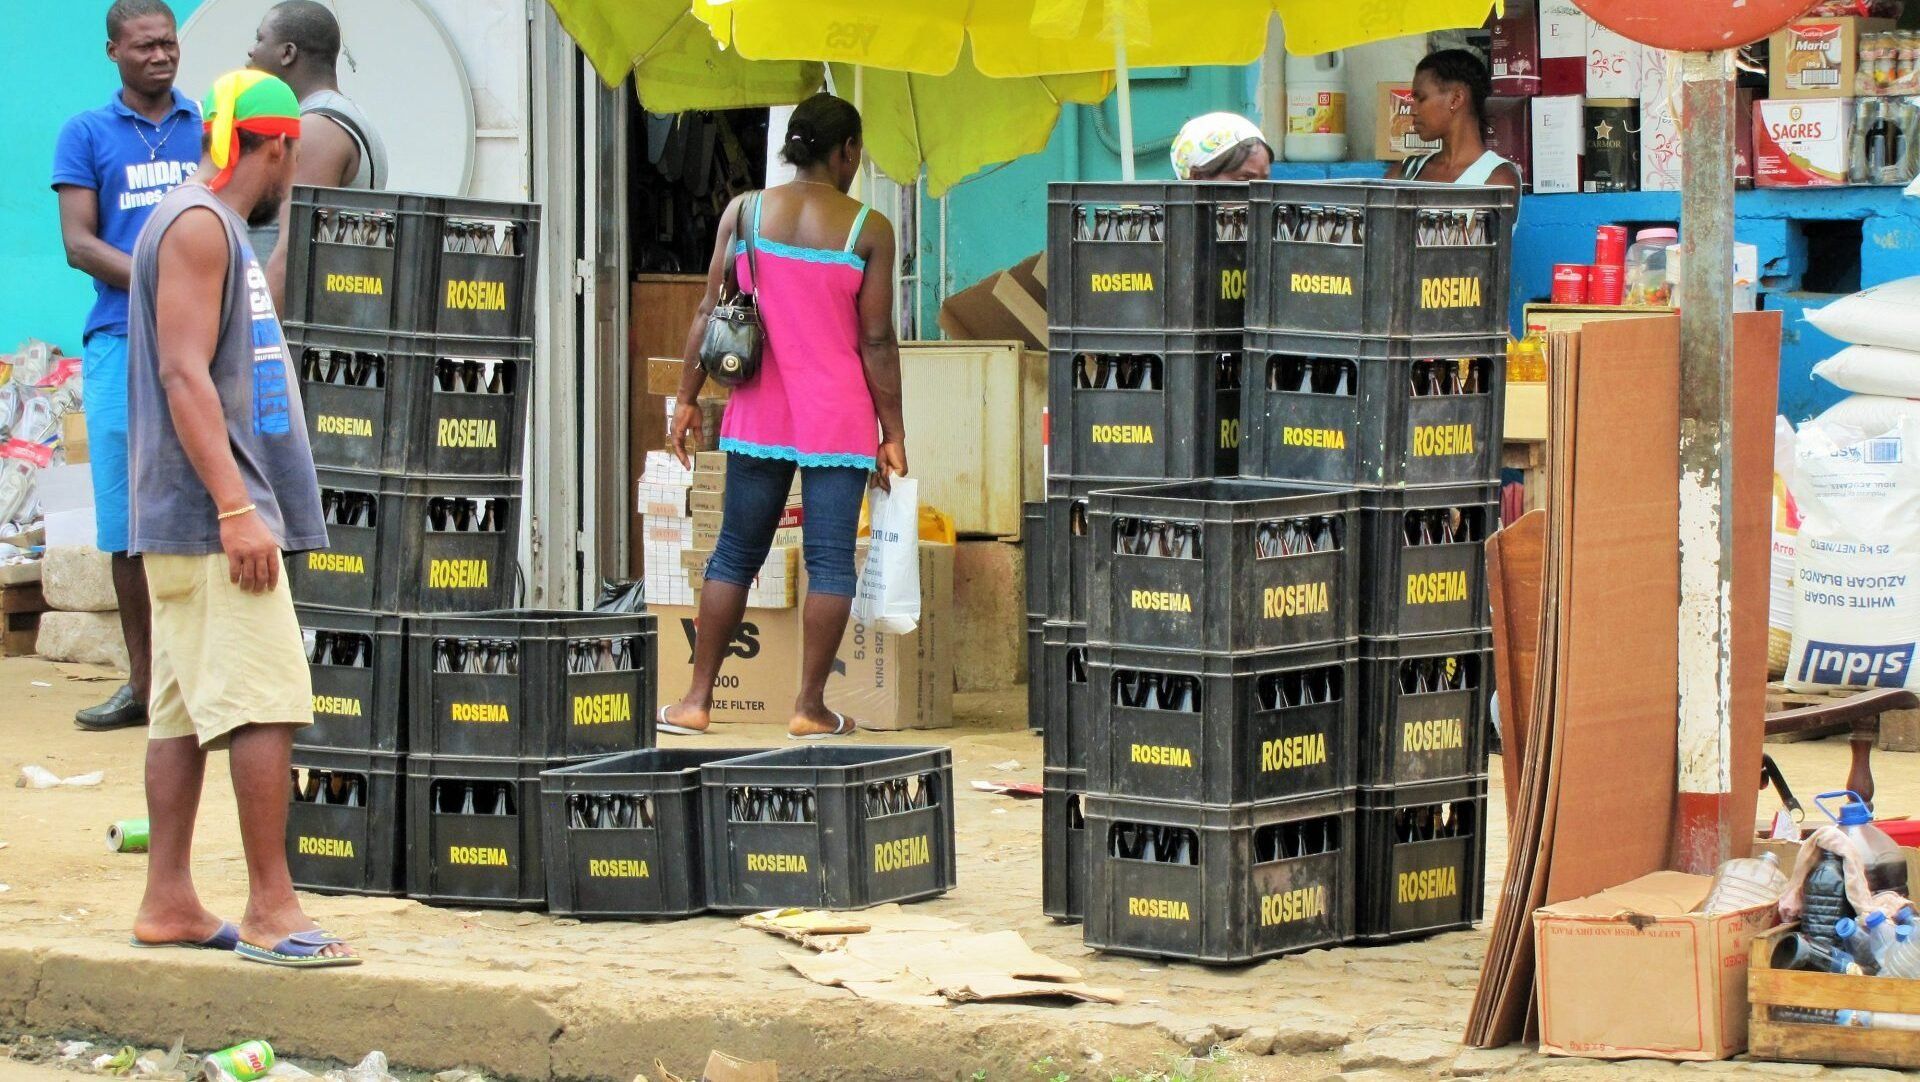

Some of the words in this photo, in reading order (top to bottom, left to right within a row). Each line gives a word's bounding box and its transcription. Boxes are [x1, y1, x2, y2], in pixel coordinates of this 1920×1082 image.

[1796, 41, 1830, 52] Maria
[1772, 121, 1822, 141] SAGRES
[325, 272, 385, 296] ROSEMA
[1091, 272, 1154, 293] ROSEMA
[1291, 272, 1354, 296] ROSEMA
[1420, 275, 1482, 309] ROSEMA
[445, 279, 506, 312] ROSEMA
[317, 414, 373, 437] ROSEMA
[437, 418, 497, 448] ROSEMA
[1092, 423, 1154, 445] ROSEMA
[1282, 426, 1346, 450] ROSEMA
[1412, 423, 1475, 457] ROSEMA
[778, 511, 798, 526] arlboro
[1810, 539, 1856, 554] NET/NETO
[1859, 543, 1873, 555] kg
[1876, 544, 1889, 554] 25
[307, 552, 365, 576] ROSEMA
[428, 557, 489, 590] ROSEMA
[1406, 569, 1468, 605] ROSEMA
[1799, 568, 1843, 587] BLANCO
[1131, 589, 1192, 612] ROSEMA
[1263, 581, 1330, 620] ROSEMA
[1804, 589, 1845, 606] SUGAR
[1849, 596, 1896, 609] WHITE
[875, 658, 884, 688] KING
[1803, 648, 1906, 689] sidul
[311, 695, 362, 717] ROSEMA
[450, 702, 509, 724] ROSEMA
[573, 693, 632, 726] ROSEMA
[709, 699, 728, 711] IZE
[730, 699, 765, 711] FILTER
[1402, 718, 1463, 753] ROSEMA
[1131, 743, 1193, 768] ROSEMA
[1261, 732, 1327, 772] ROSEMA
[298, 836, 354, 858] ROSEMA
[449, 845, 509, 867] ROSEMA
[874, 834, 930, 873] ROSEMA
[589, 858, 650, 879] ROSEMA
[746, 853, 808, 874] ROSEMA
[1397, 865, 1457, 904] ROSEMA
[1128, 896, 1191, 922] ROSEMA
[1261, 884, 1326, 927] ROSEMA
[1594, 928, 1613, 937] AND
